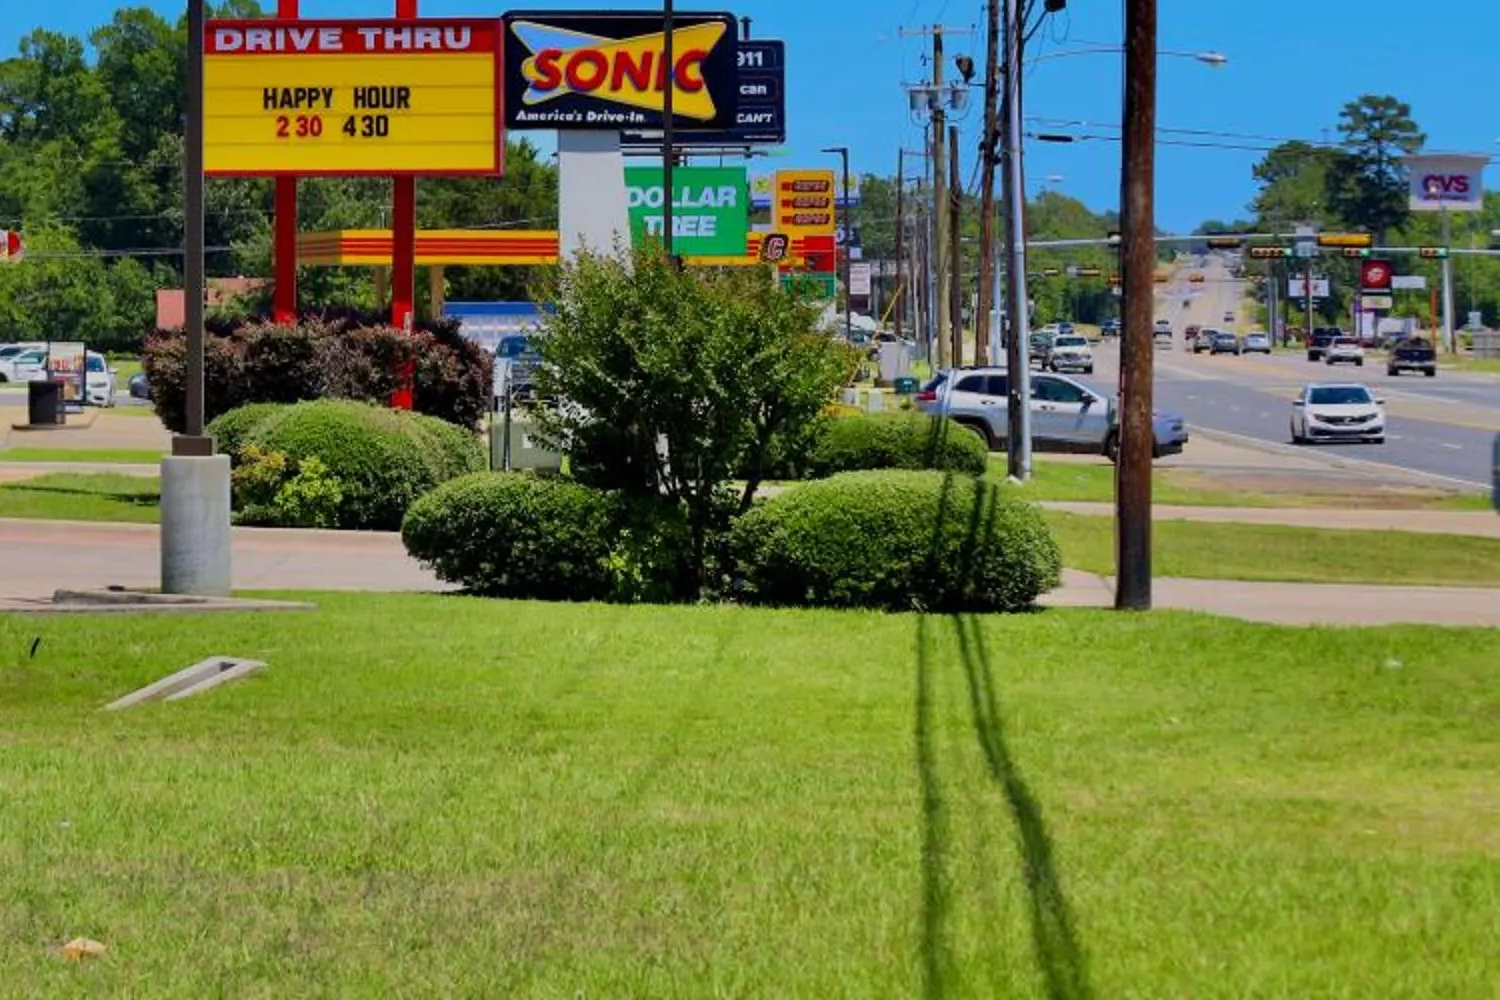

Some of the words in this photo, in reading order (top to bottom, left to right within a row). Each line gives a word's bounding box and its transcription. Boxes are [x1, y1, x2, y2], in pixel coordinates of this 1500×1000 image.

[215, 27, 343, 51] DRIVE
[358, 26, 471, 49] THRU
[534, 48, 708, 93] SONIC
[263, 87, 334, 110] HAPPY
[354, 86, 411, 109] HOUR
[515, 109, 583, 121] America's
[1422, 174, 1469, 193] CVS
[643, 215, 717, 236] TREE
